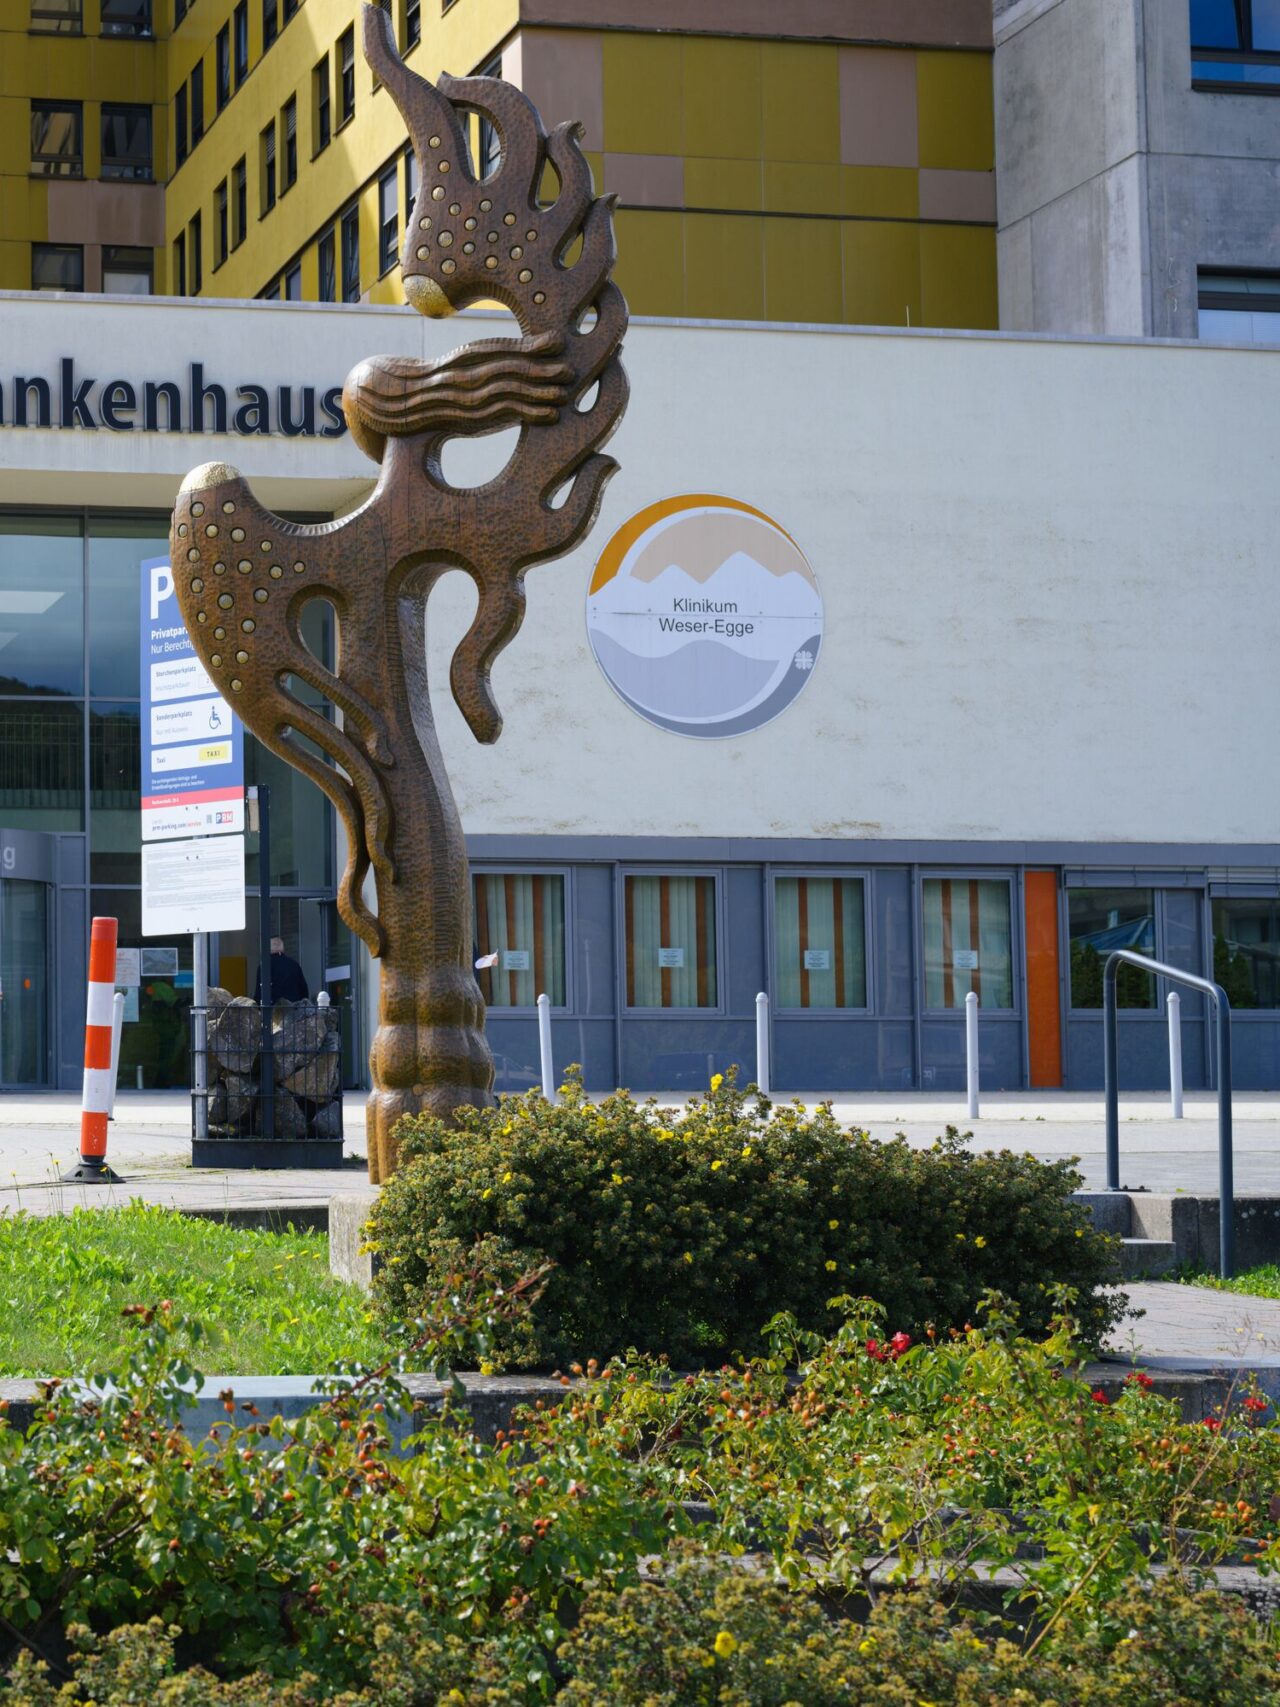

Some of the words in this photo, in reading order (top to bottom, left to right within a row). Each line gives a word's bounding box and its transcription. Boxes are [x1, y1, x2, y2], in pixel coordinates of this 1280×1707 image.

[151, 566, 175, 620] P
[673, 598, 738, 613] Klinikum
[151, 626, 188, 640] Privatpar
[658, 618, 754, 637] Weser-Egge
[151, 644, 163, 655] Nur
[164, 639, 195, 652] Berechti
[207, 750, 220, 758] TAXI
